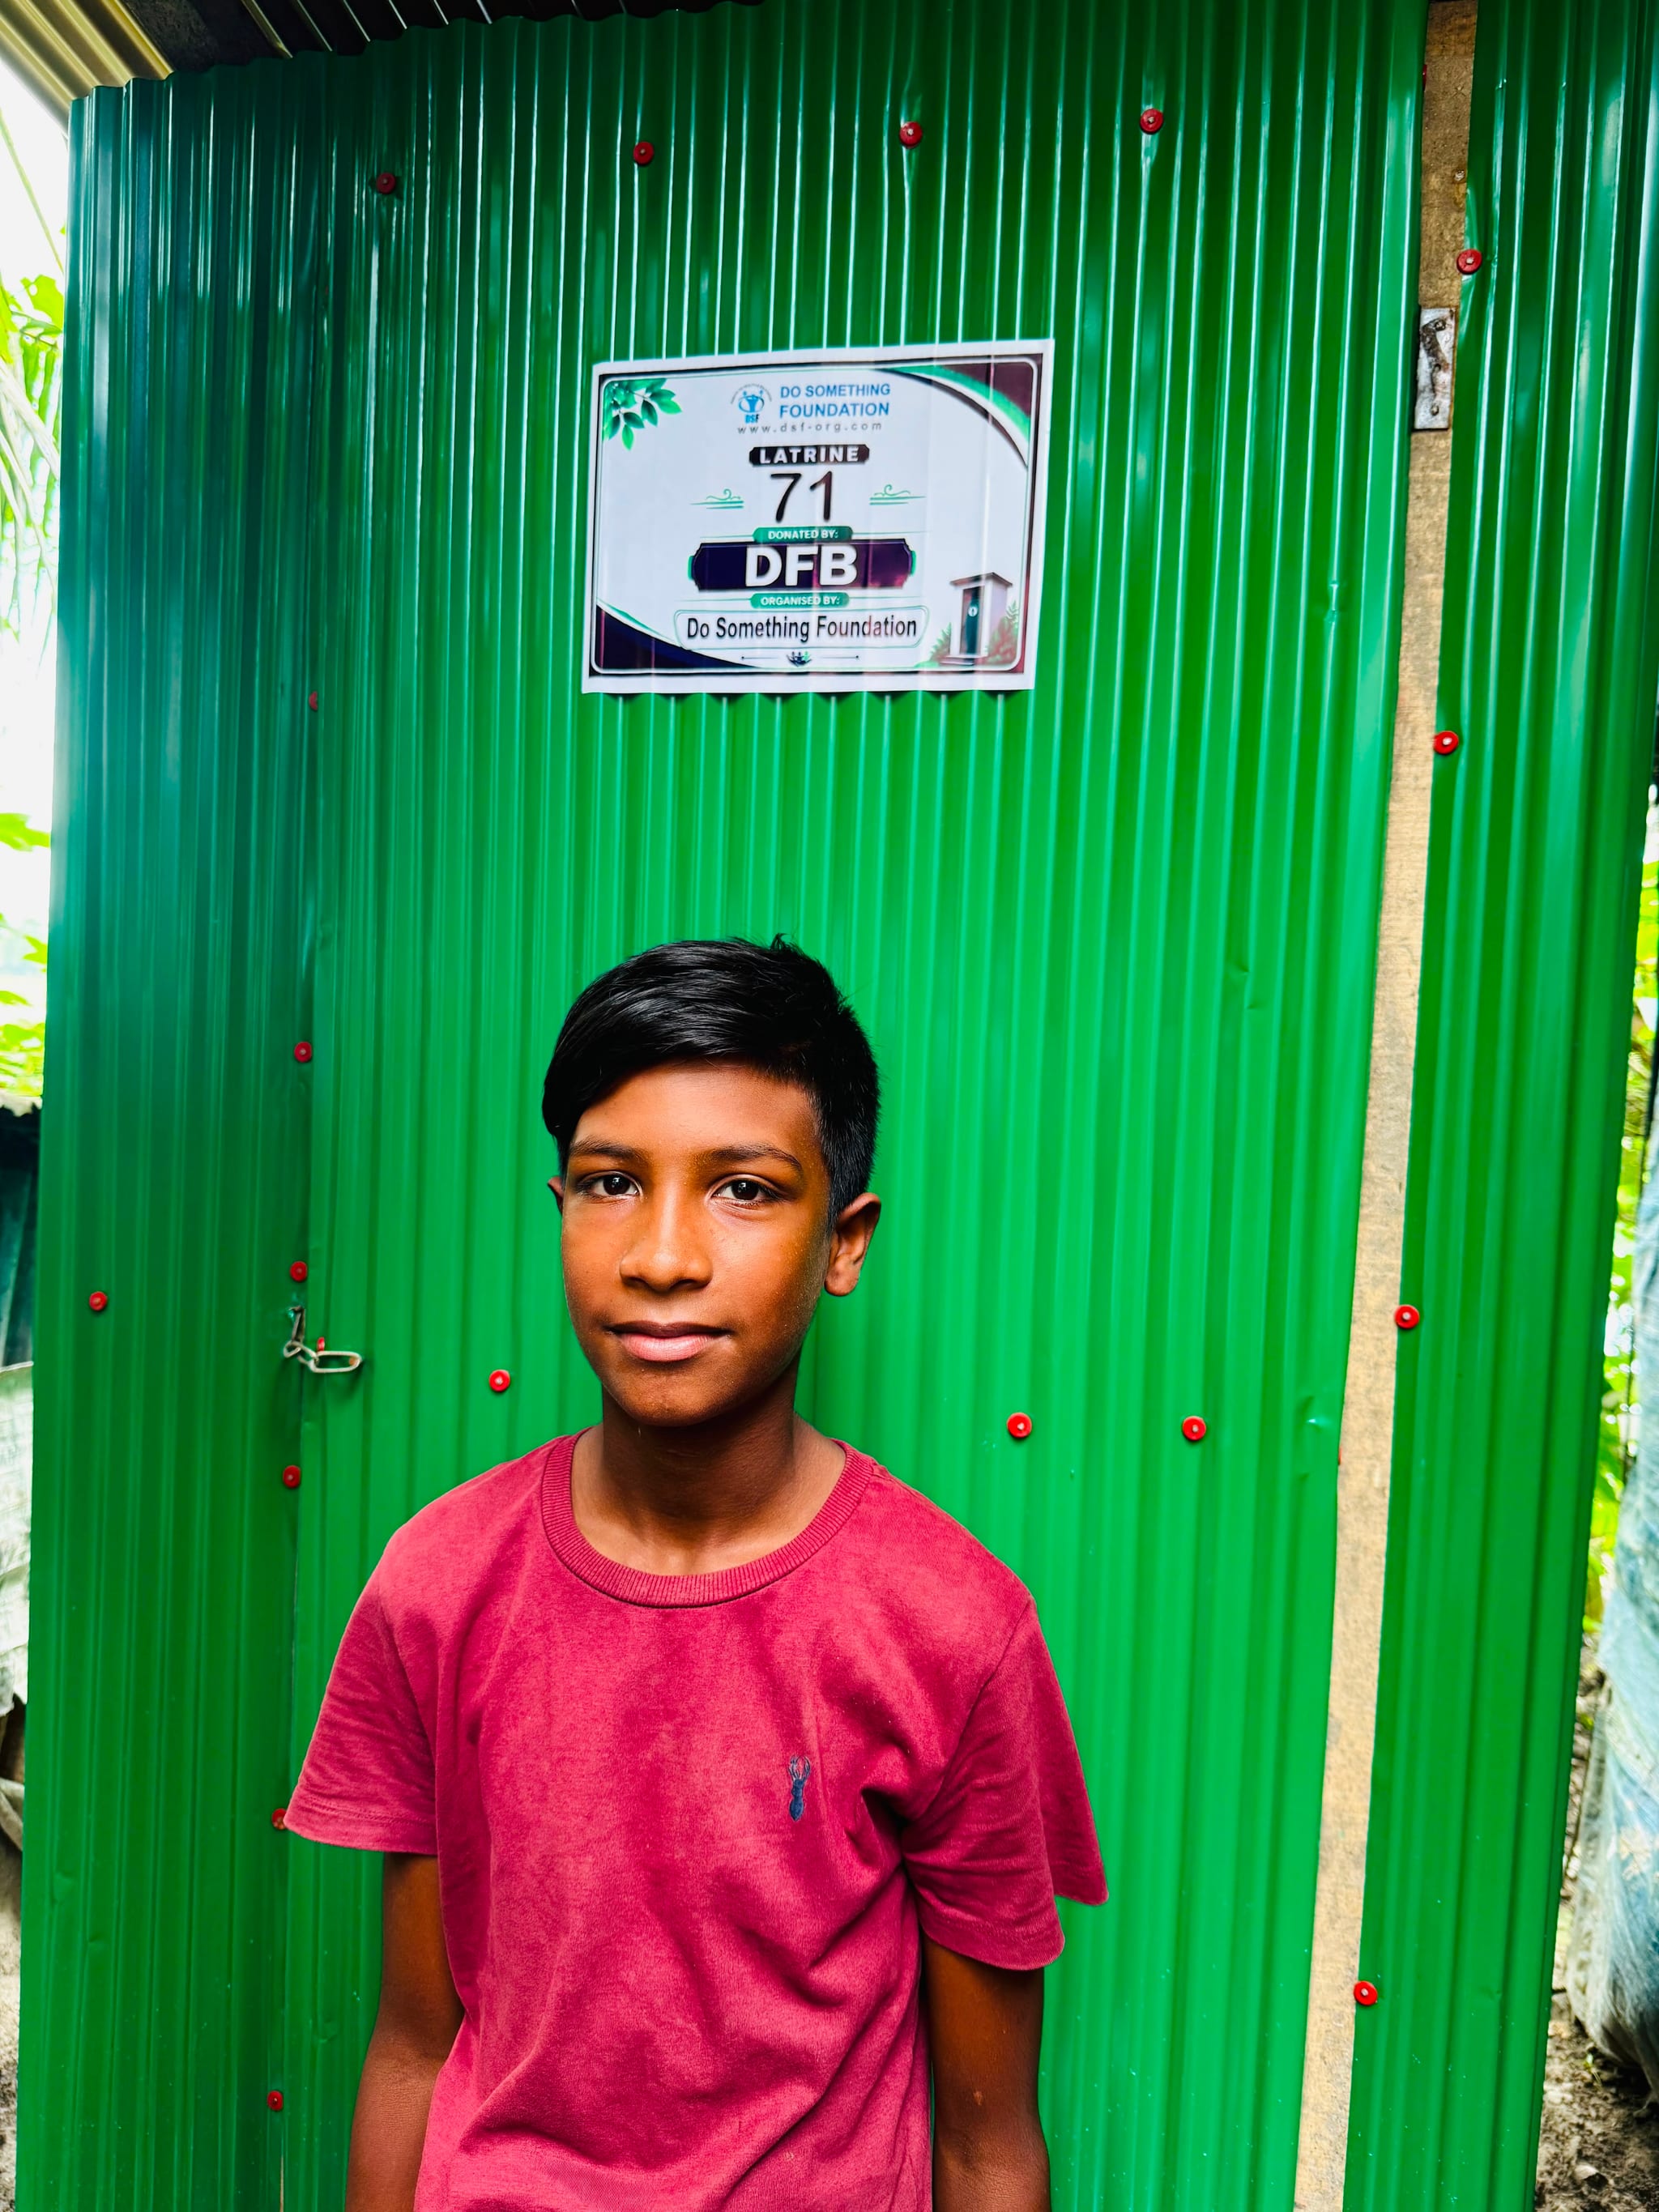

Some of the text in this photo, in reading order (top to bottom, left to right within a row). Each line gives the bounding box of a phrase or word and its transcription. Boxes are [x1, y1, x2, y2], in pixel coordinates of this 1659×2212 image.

[780, 386, 801, 399] DO
[805, 383, 891, 398] SOMETHING
[779, 403, 889, 418] FOUNDATION
[745, 414, 759, 424] DSF
[737, 422, 882, 435] www.dsf-org.com
[759, 446, 859, 464] LATRINE
[770, 471, 833, 522] 71
[768, 529, 838, 539] DONATED BY:
[745, 544, 857, 587] DFB
[761, 596, 840, 606] ORGANISED BY:
[688, 615, 916, 642] Do Something Foundation
